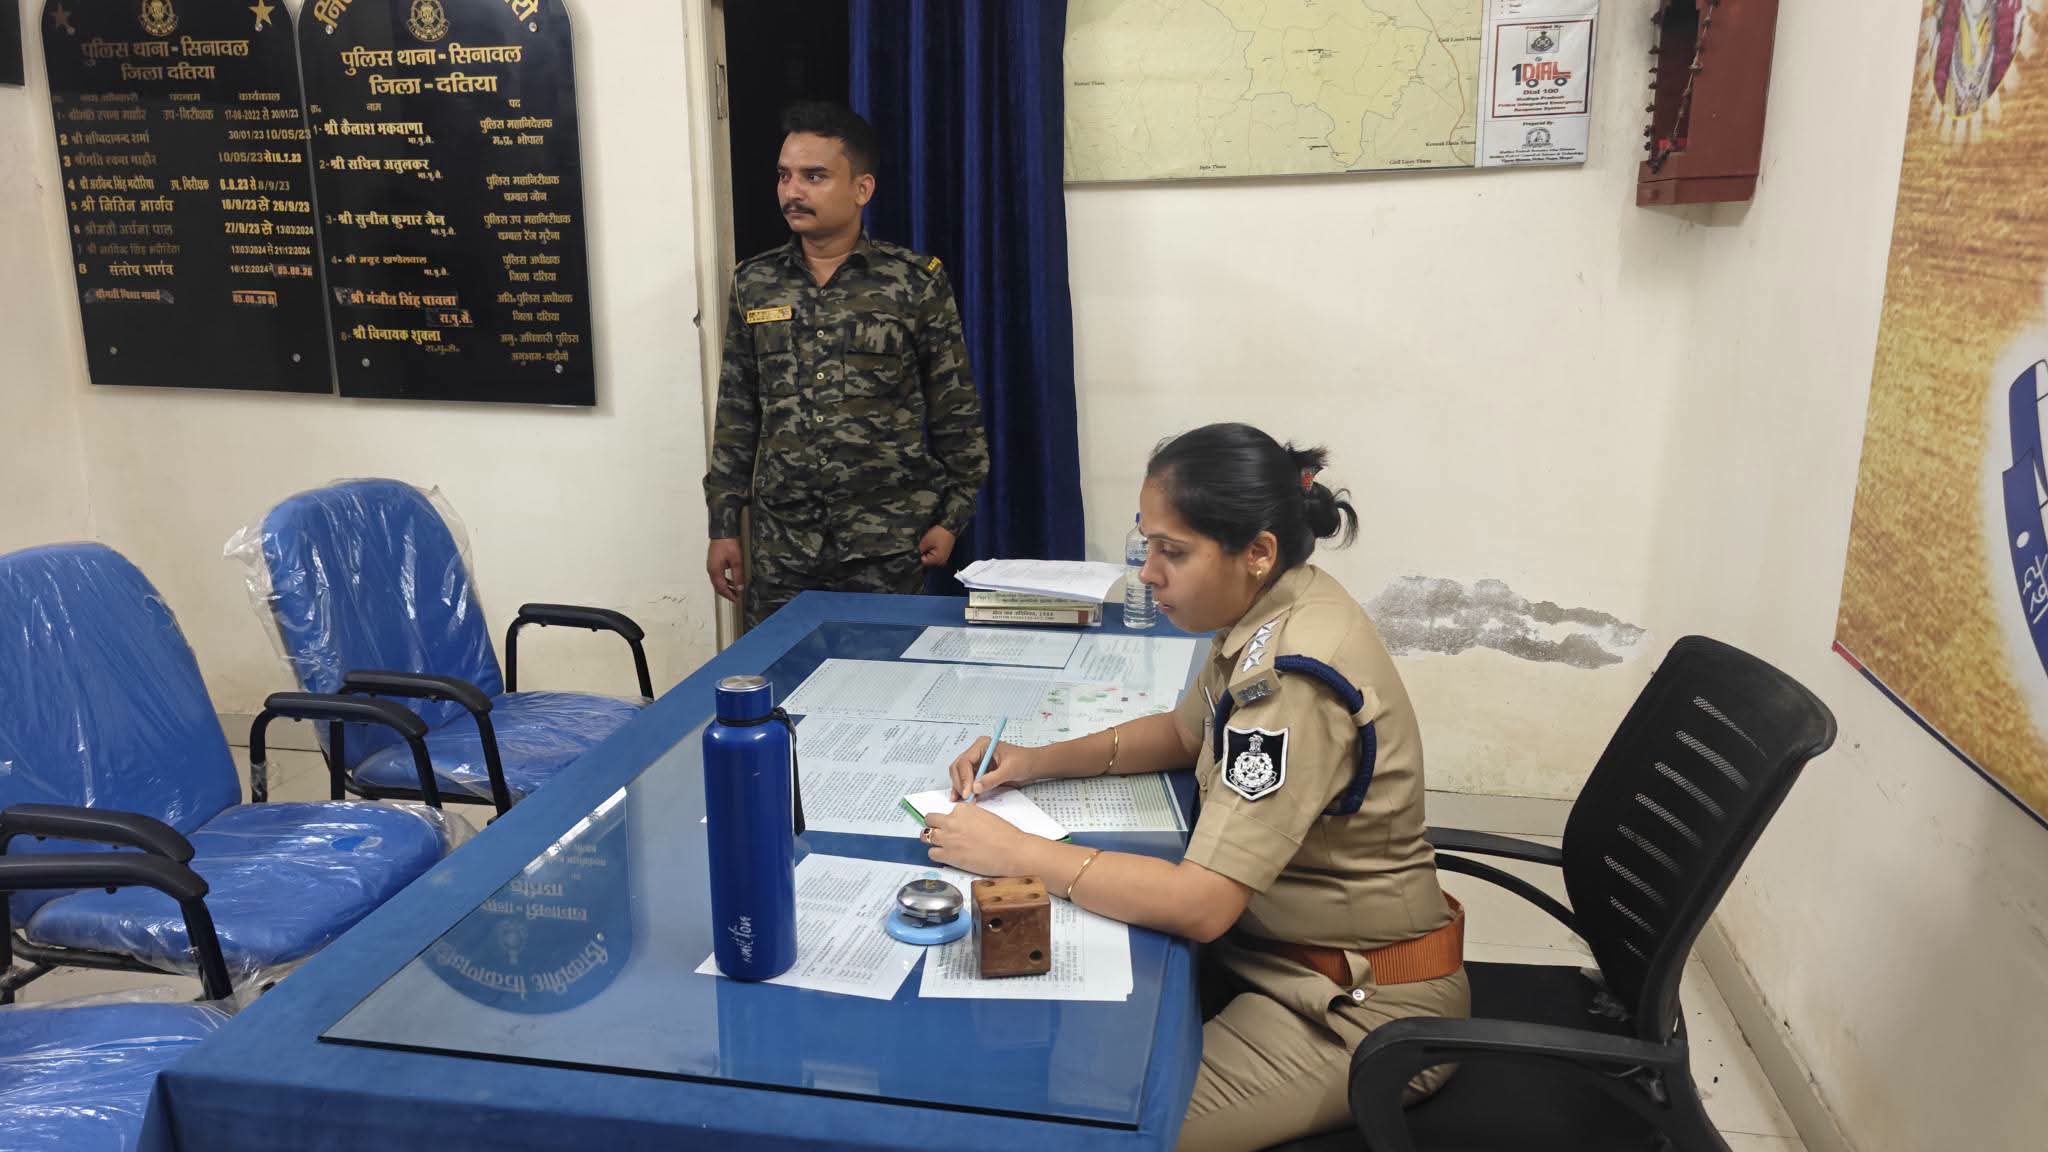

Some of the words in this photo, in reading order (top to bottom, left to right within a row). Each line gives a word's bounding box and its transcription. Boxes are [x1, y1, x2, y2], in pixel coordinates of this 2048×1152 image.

[81, 37, 129, 66] पुलिस
[341, 46, 392, 76] पुलिस
[121, 63, 163, 81] जिला
[167, 62, 216, 80] दतिया
[367, 102, 381, 112] नाम
[508, 98, 521, 108] पद
[324, 119, 338, 135] श्री
[340, 118, 375, 135] कैलाश
[378, 122, 424, 135] मकवाणा
[480, 117, 505, 134] पुलिस
[60, 133, 68, 145] 2
[228, 130, 265, 140] 30/01/23
[266, 129, 311, 140] 10/05/23
[517, 132, 544, 145] भोपाल
[63, 155, 71, 167] 3
[330, 155, 345, 170] श्री
[348, 155, 381, 170] सचिन
[383, 159, 429, 174] अतुलकर
[68, 179, 75, 190] 4
[486, 173, 510, 190] पुलिस
[81, 195, 95, 212] श्री
[99, 195, 136, 212] नितिन
[140, 195, 175, 212] भार्गव
[257, 195, 271, 212] से
[260, 219, 274, 235] से
[338, 211, 353, 225] श्री
[355, 211, 389, 228] सुनील
[391, 214, 422, 229] कुमार
[424, 210, 445, 225] जैन
[484, 212, 508, 229] पुलिस
[509, 214, 521, 225] उप
[108, 260, 141, 276] संतोष
[143, 260, 174, 276] भार्गव
[502, 253, 527, 270] पुलिस
[351, 290, 364, 304] श्री
[399, 291, 421, 308] सिंह
[353, 324, 366, 340] श्री
[368, 325, 409, 341] विनायक
